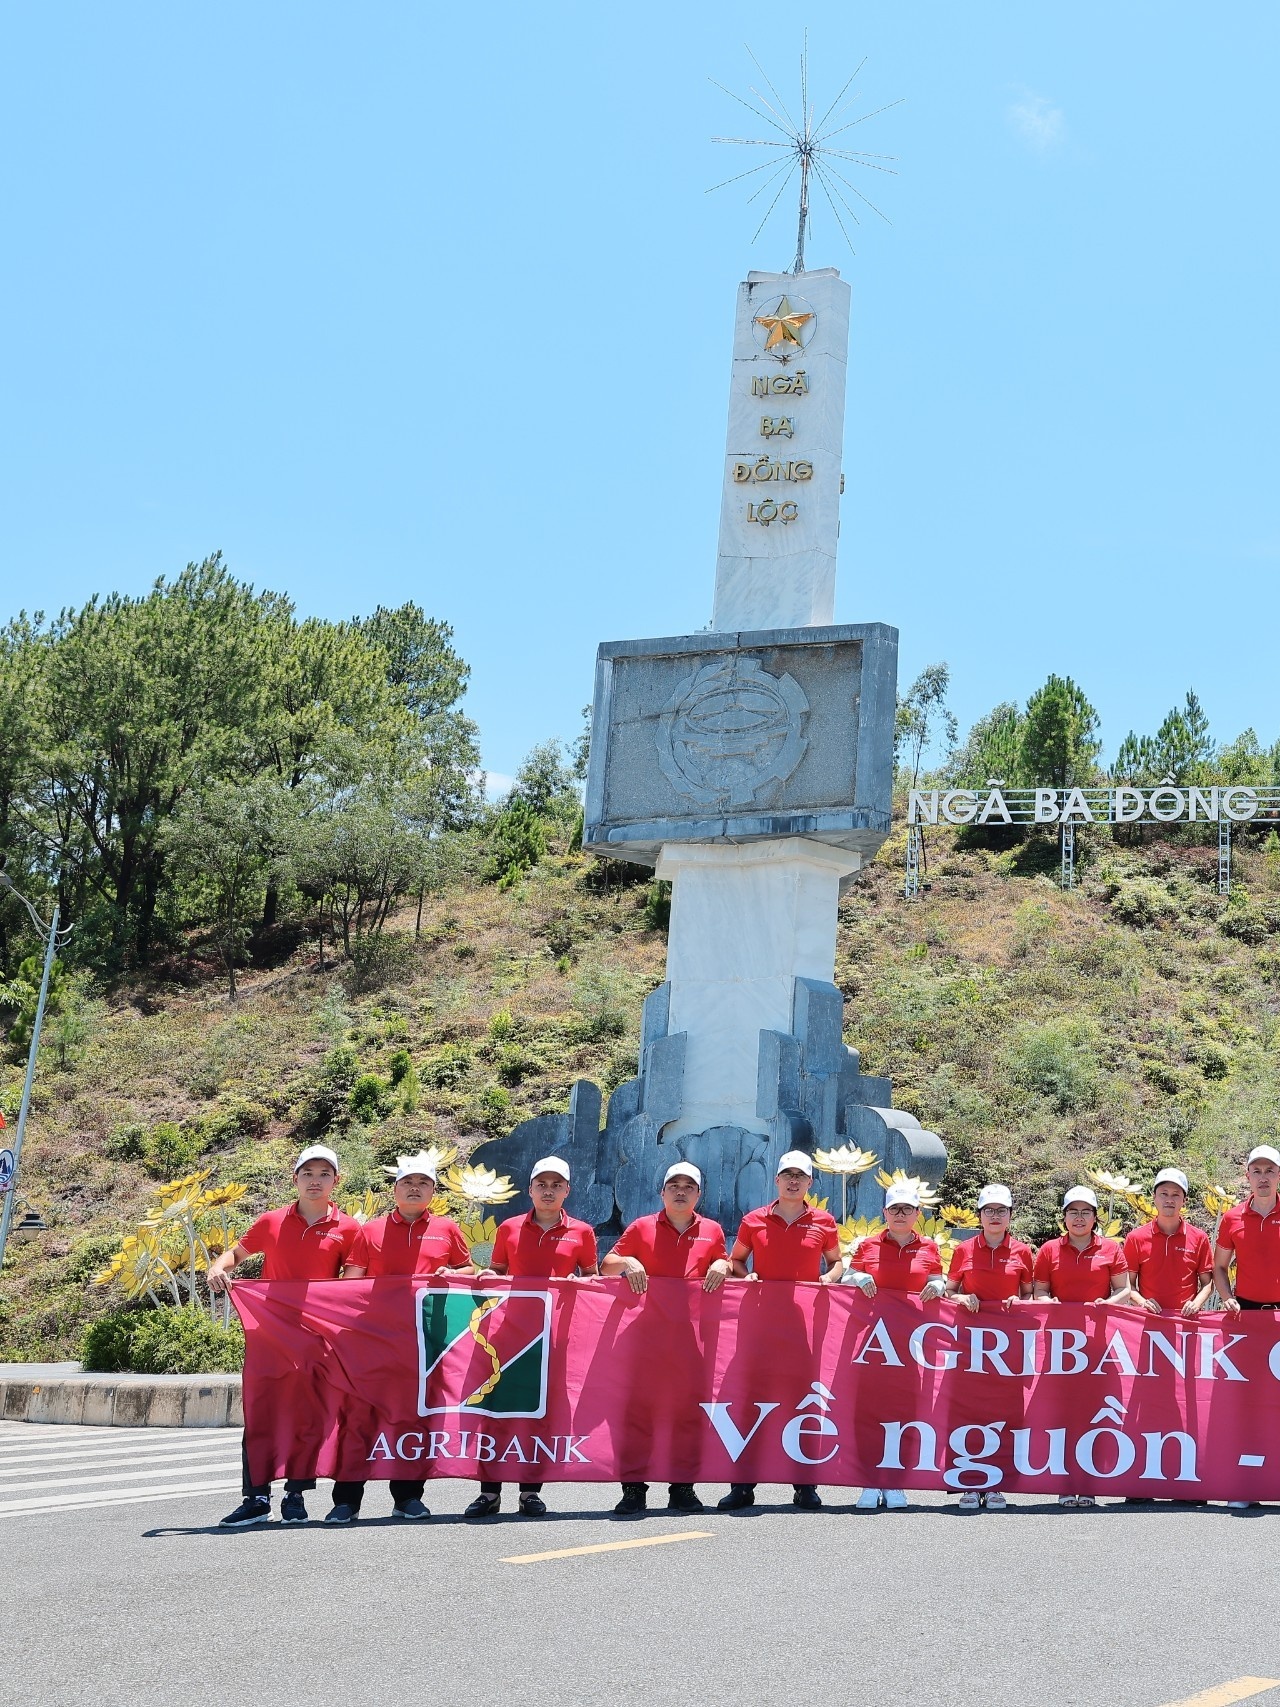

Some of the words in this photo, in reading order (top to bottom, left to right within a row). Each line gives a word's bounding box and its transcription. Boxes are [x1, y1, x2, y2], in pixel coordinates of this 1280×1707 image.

[751, 370, 809, 397] NGÃ
[760, 415, 793, 437] BA
[907, 778, 1013, 825] NGÃ
[1034, 786, 1095, 824] BA
[1114, 770, 1259, 823] ĐỒNG
[853, 1317, 1249, 1382] AGRIBANK
[366, 1431, 592, 1464] AGRIBANK
[699, 1381, 840, 1465] Về
[876, 1396, 1201, 1489] nguồn
[1238, 1454, 1265, 1467] -
